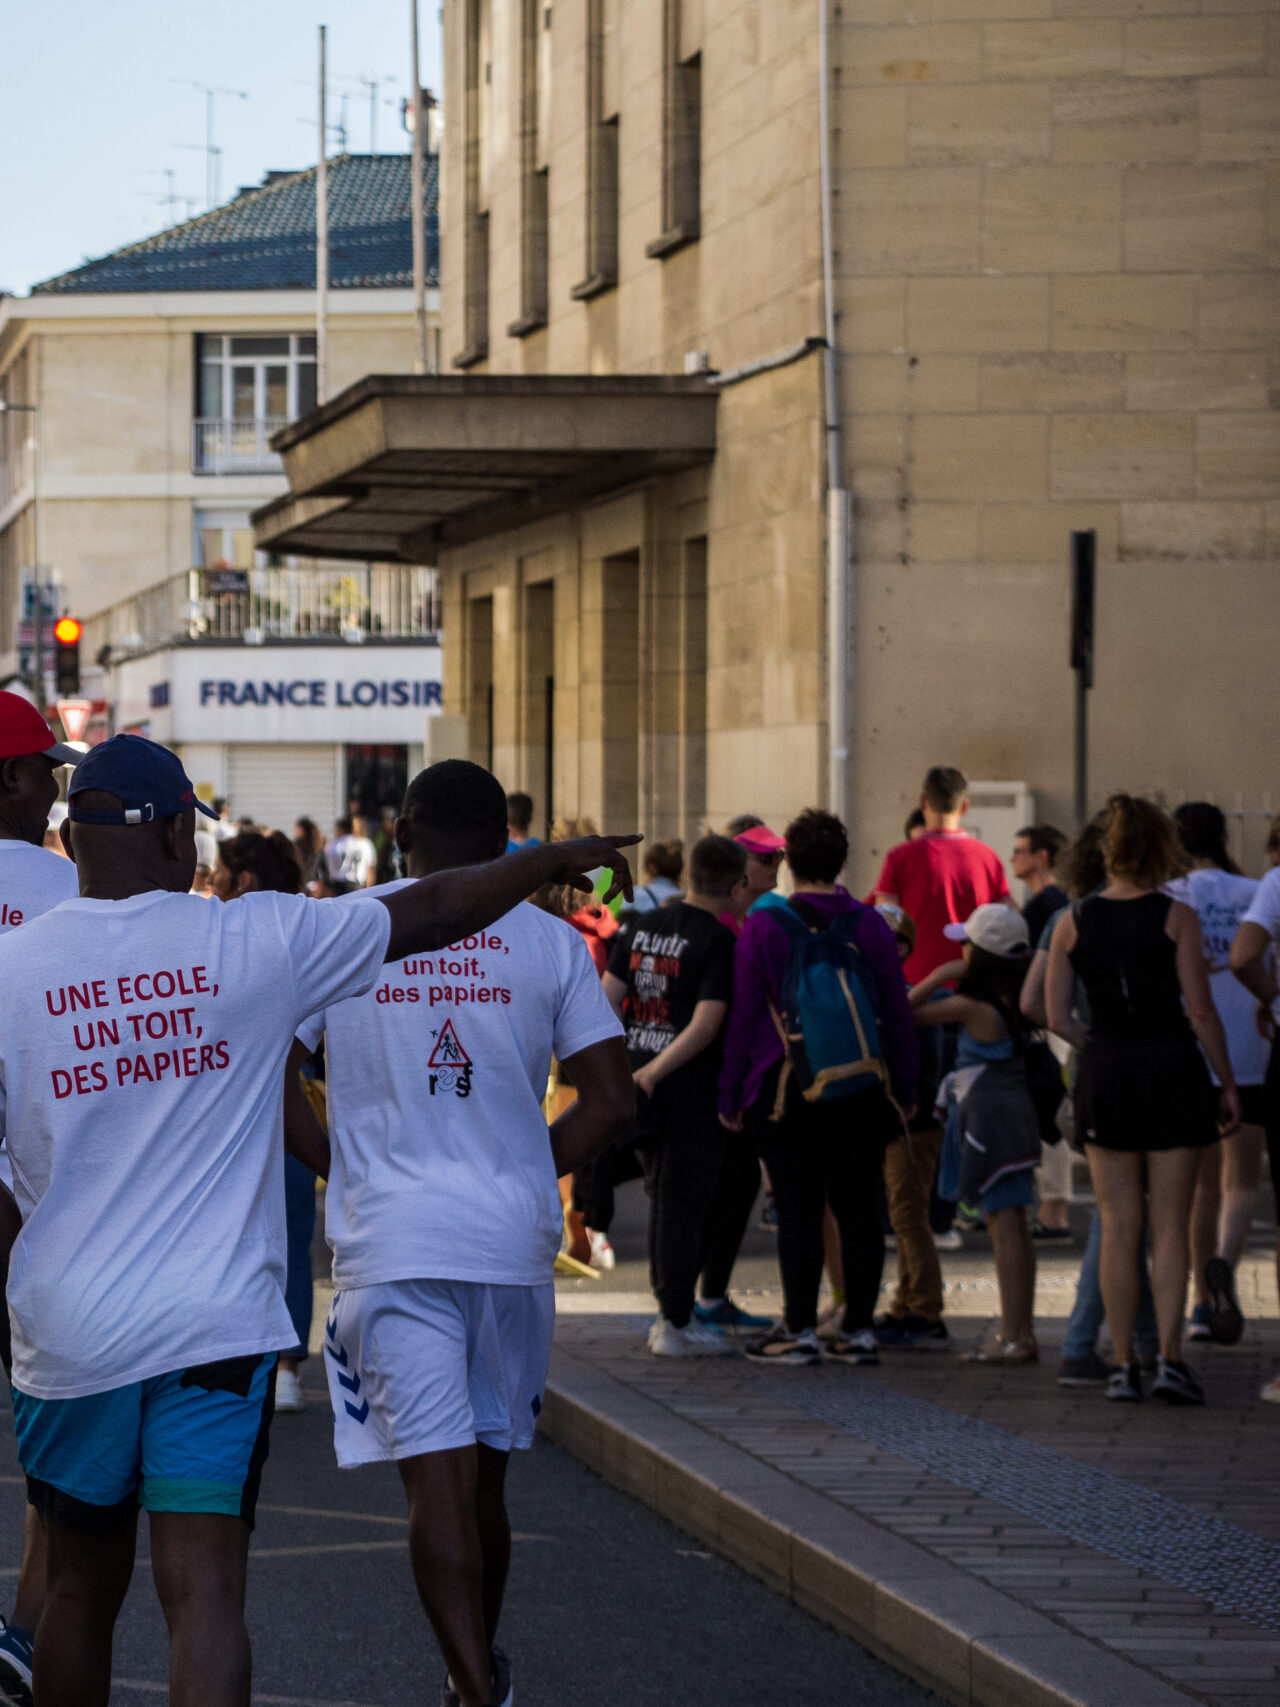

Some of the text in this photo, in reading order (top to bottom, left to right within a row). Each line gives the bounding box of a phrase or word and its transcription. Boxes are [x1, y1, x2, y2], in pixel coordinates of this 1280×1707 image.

[199, 680, 326, 707] FRANCE
[440, 931, 509, 955] ole,
[403, 957, 486, 980] un toit,
[45, 965, 219, 1017] UNE ECOLE,
[375, 983, 512, 1007] des papiers
[73, 1006, 203, 1051] UN TOIT,
[51, 1040, 230, 1099] DES PAPIERS
